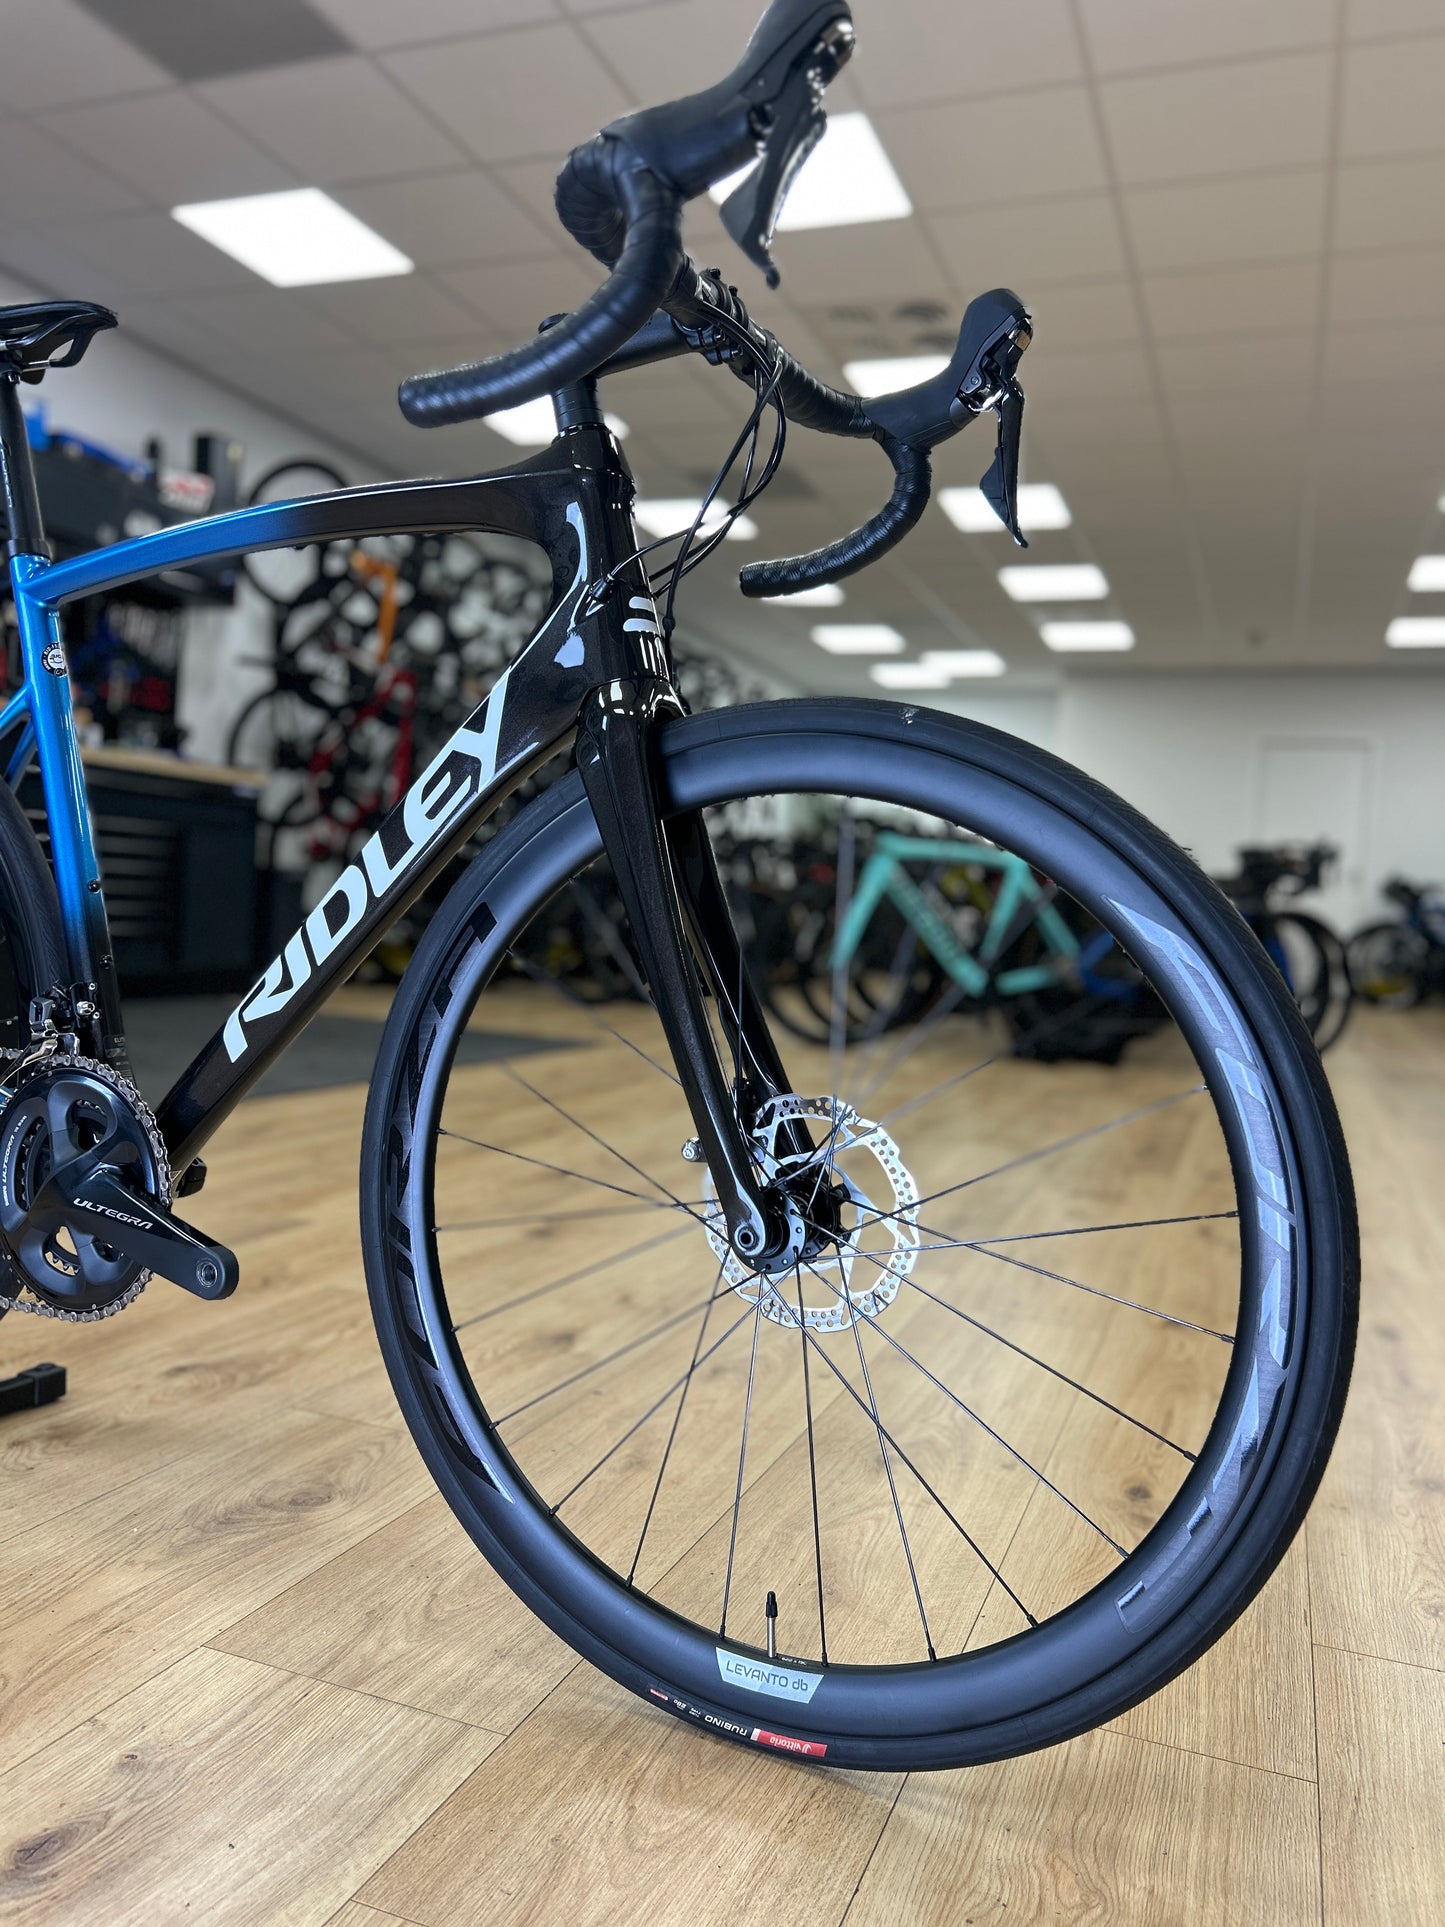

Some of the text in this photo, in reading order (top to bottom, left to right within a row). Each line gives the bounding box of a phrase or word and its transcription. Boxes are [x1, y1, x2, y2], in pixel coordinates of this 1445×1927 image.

[223, 666, 512, 1063] RIDLEY
[73, 1198, 153, 1229] ULTEGRA
[726, 1660, 788, 1688] LEVANTO
[792, 1677, 808, 1691] db
[705, 1714, 748, 1736] RUBINO
